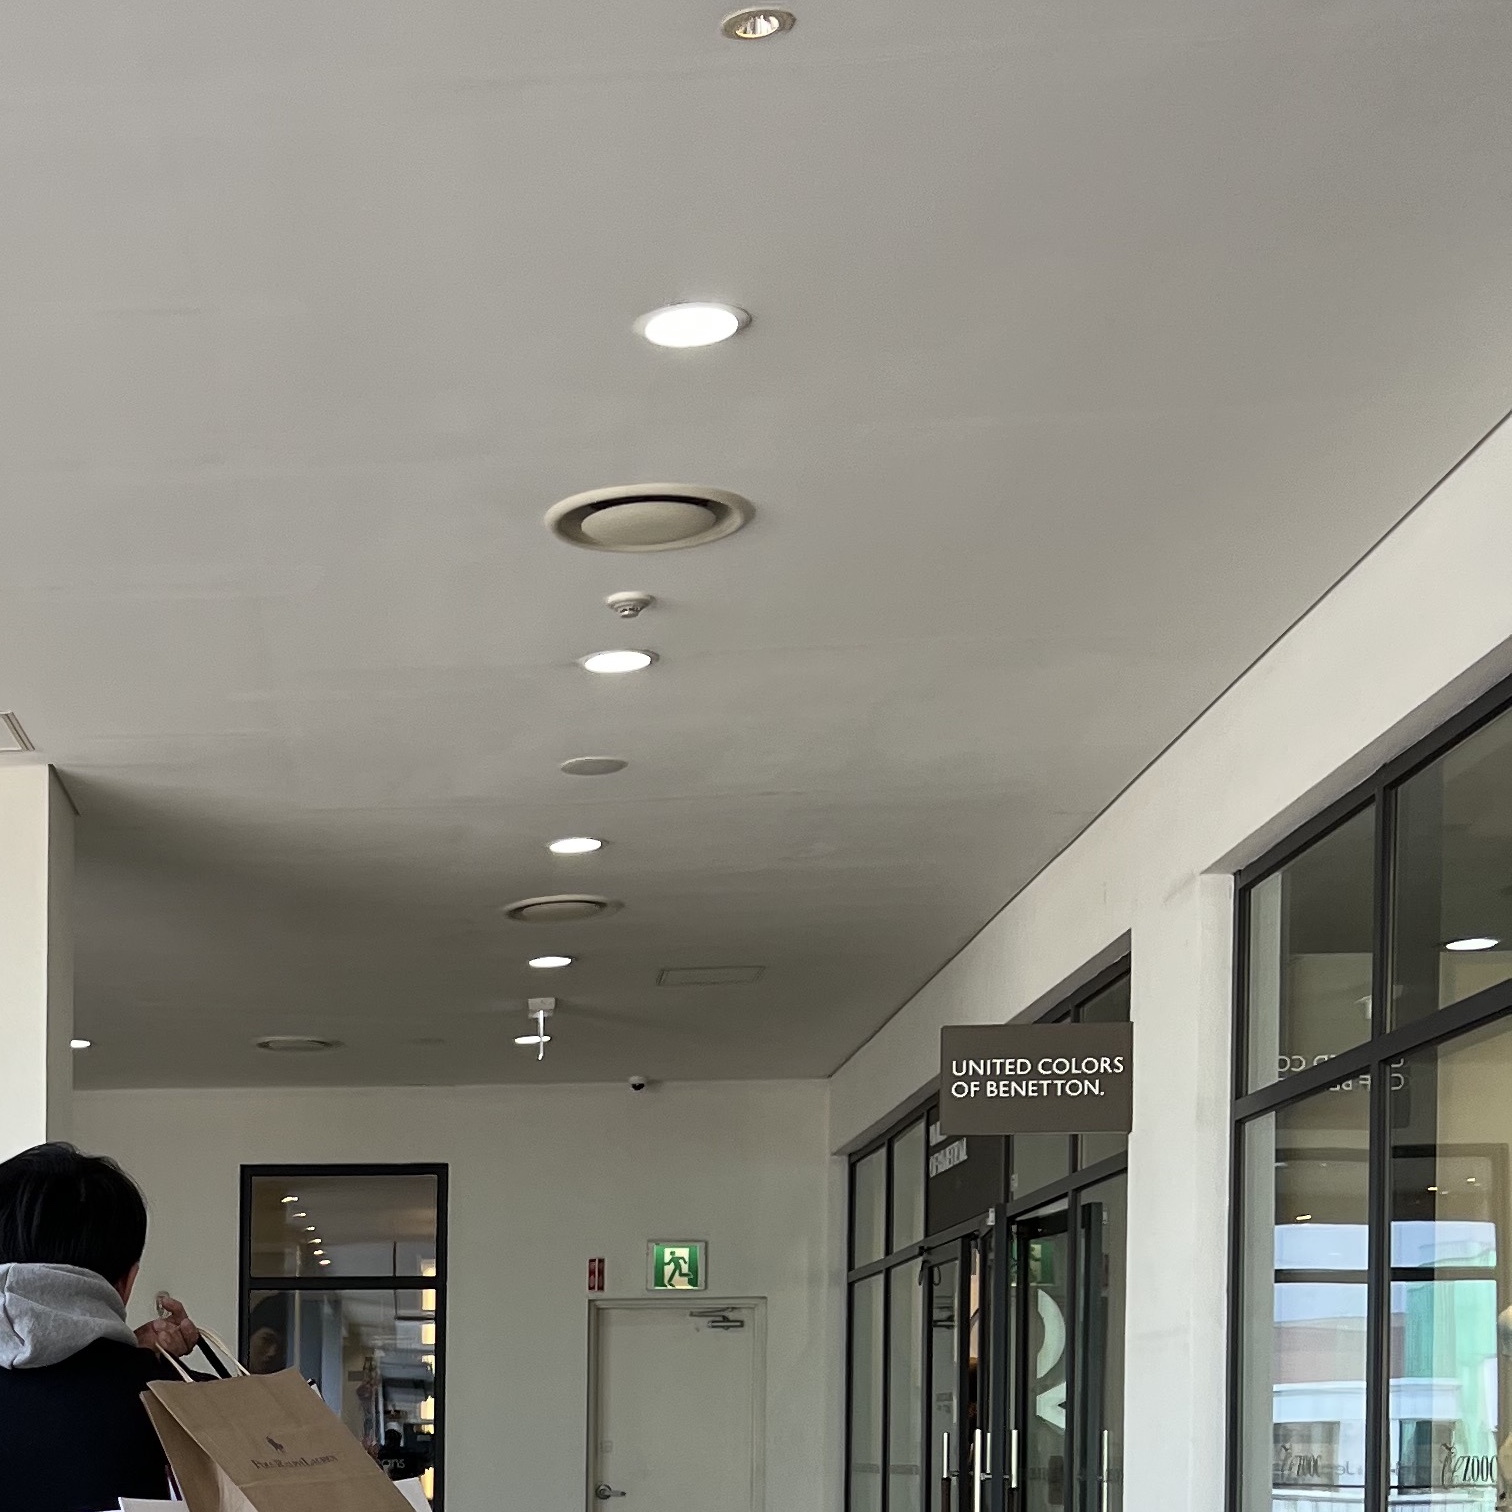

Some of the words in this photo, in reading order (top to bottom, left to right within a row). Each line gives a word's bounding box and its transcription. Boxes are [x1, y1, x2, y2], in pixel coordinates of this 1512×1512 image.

[951, 1058, 1032, 1077] UNITED
[1037, 1056, 1124, 1076] COLORS
[950, 1081, 981, 1098] OF
[986, 1078, 1105, 1098] BENETTON.
